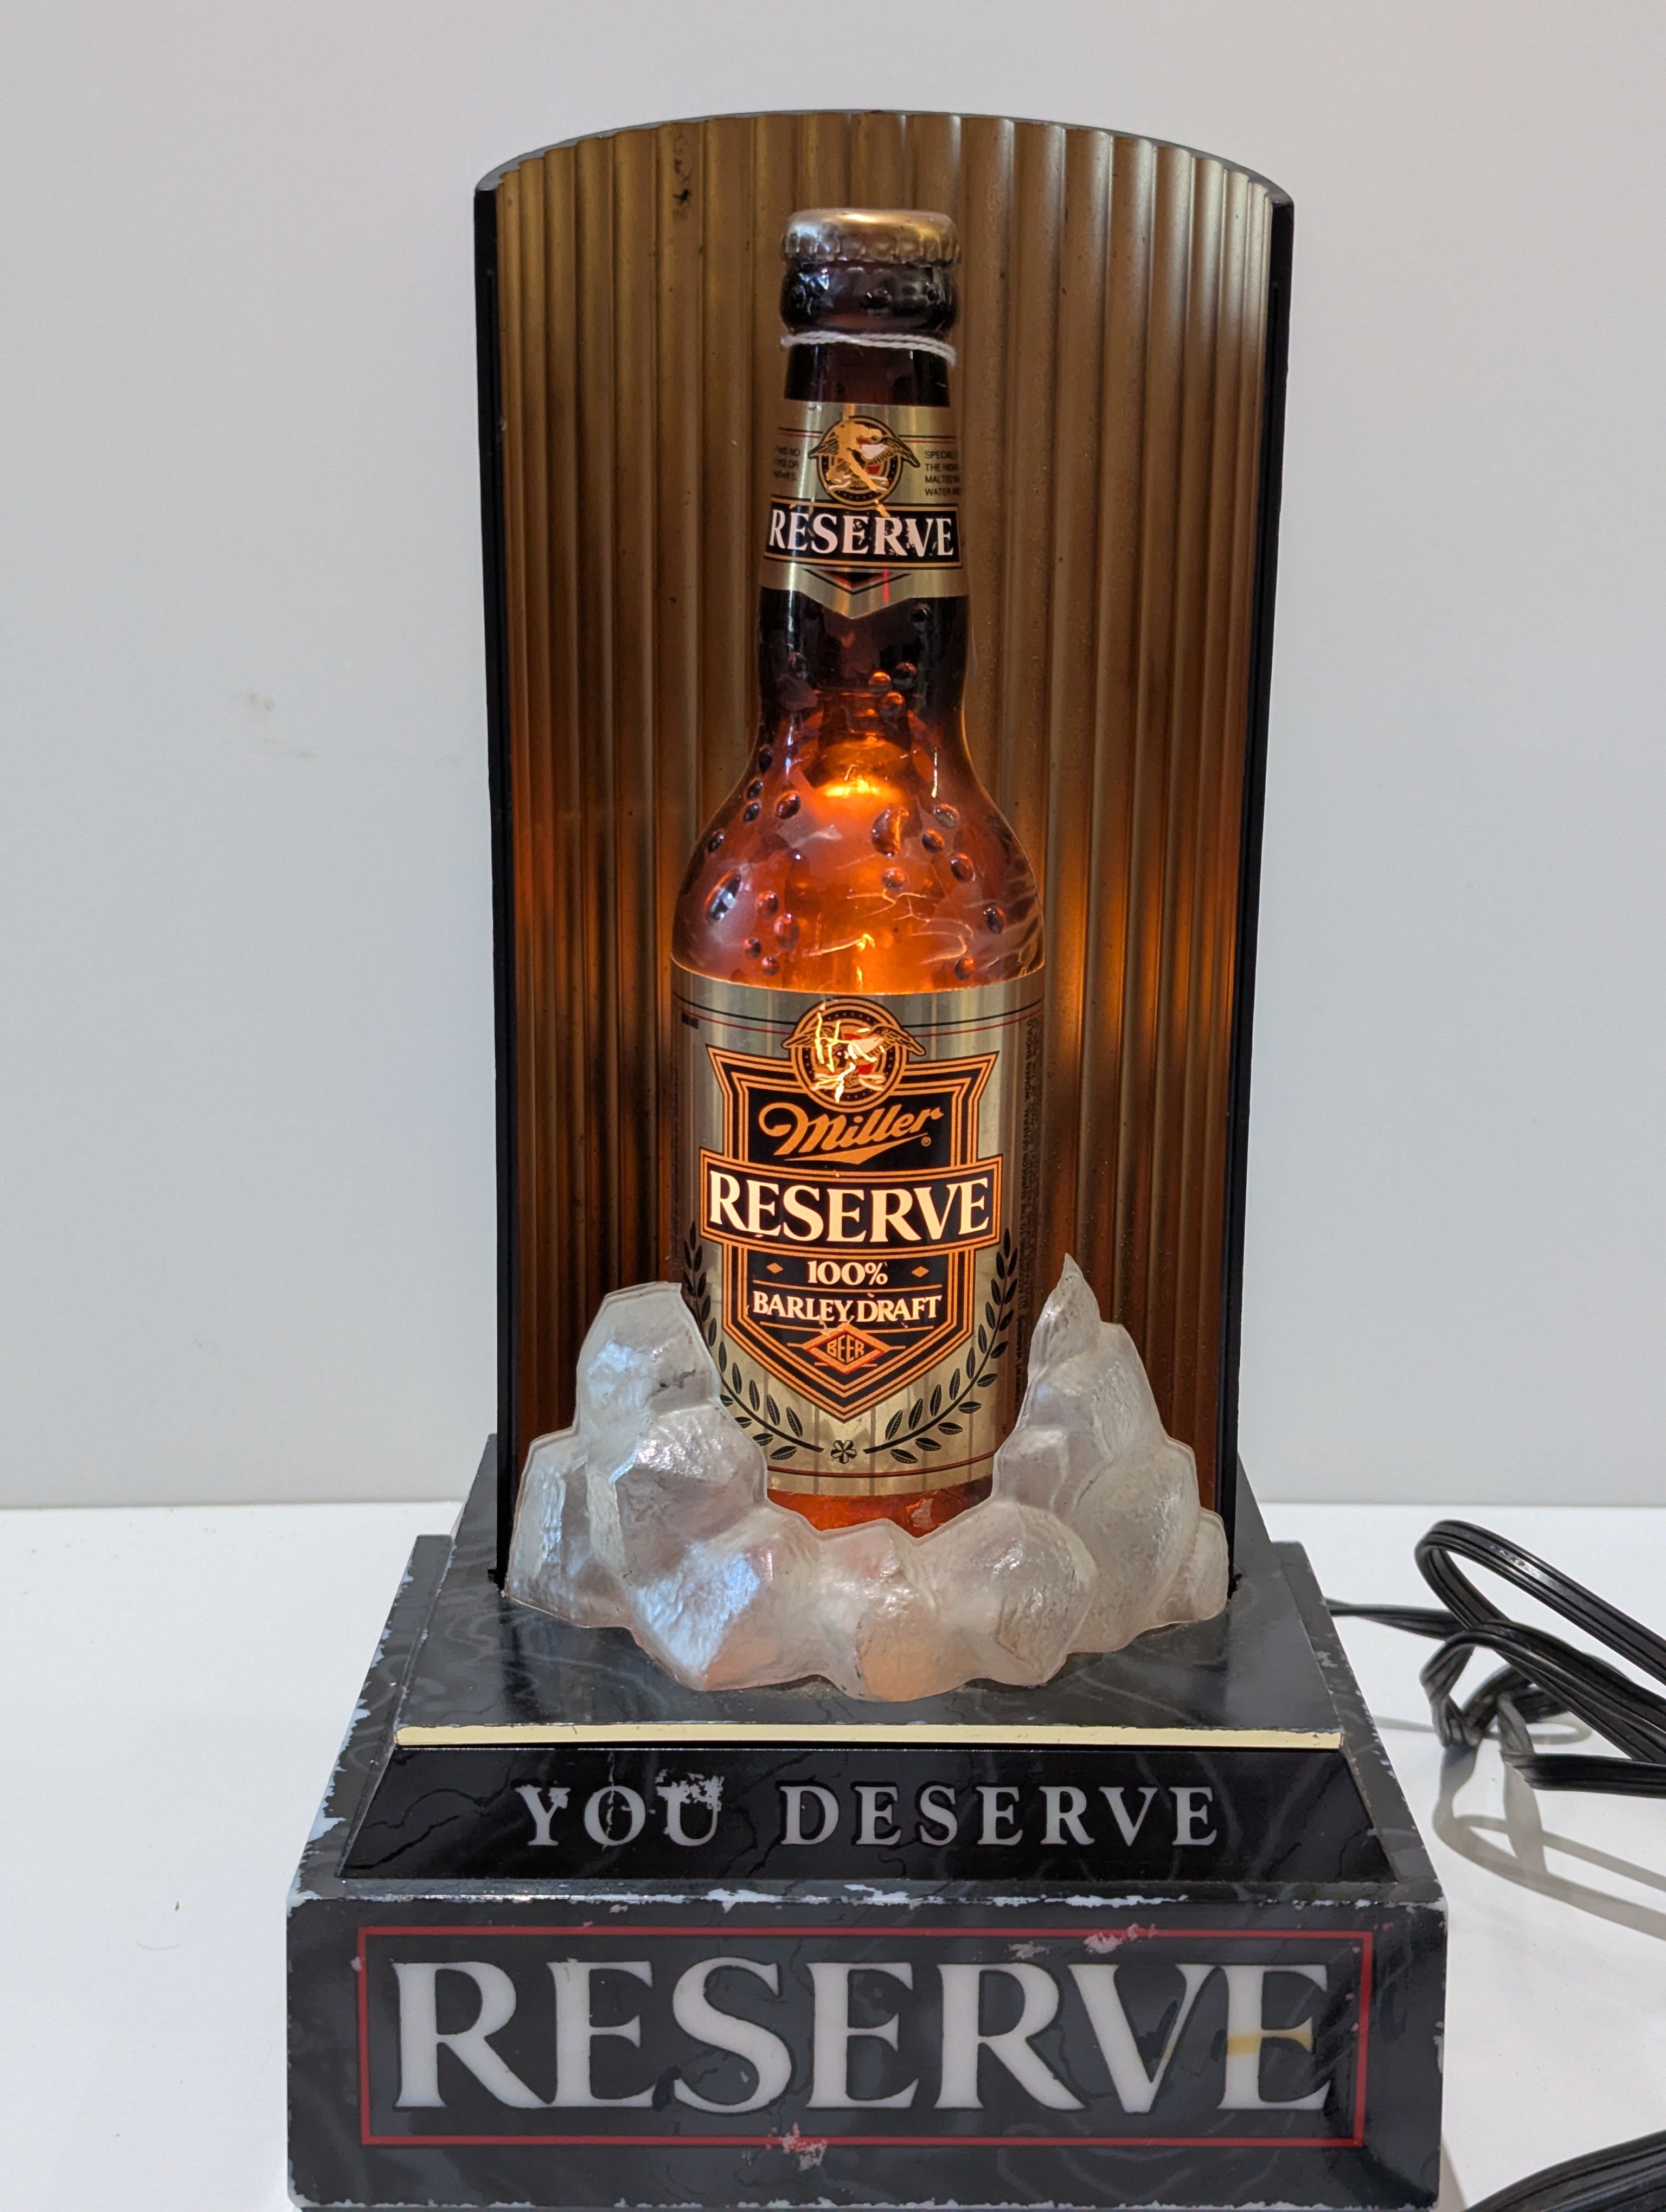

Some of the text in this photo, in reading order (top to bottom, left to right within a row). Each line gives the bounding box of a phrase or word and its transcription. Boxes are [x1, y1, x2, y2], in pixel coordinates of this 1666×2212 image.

[924, 463, 941, 472] THE
[768, 509, 954, 558] RESERVE
[758, 1102, 945, 1156] Miller
[708, 1169, 990, 1244] RESERVE
[807, 1259, 889, 1286] 100%
[753, 1290, 943, 1323] BARLEY DRAFT
[826, 1334, 866, 1362] BEER
[514, 1782, 1219, 1847] YOU DESERVE
[394, 1957, 1331, 2114] RESERVE
